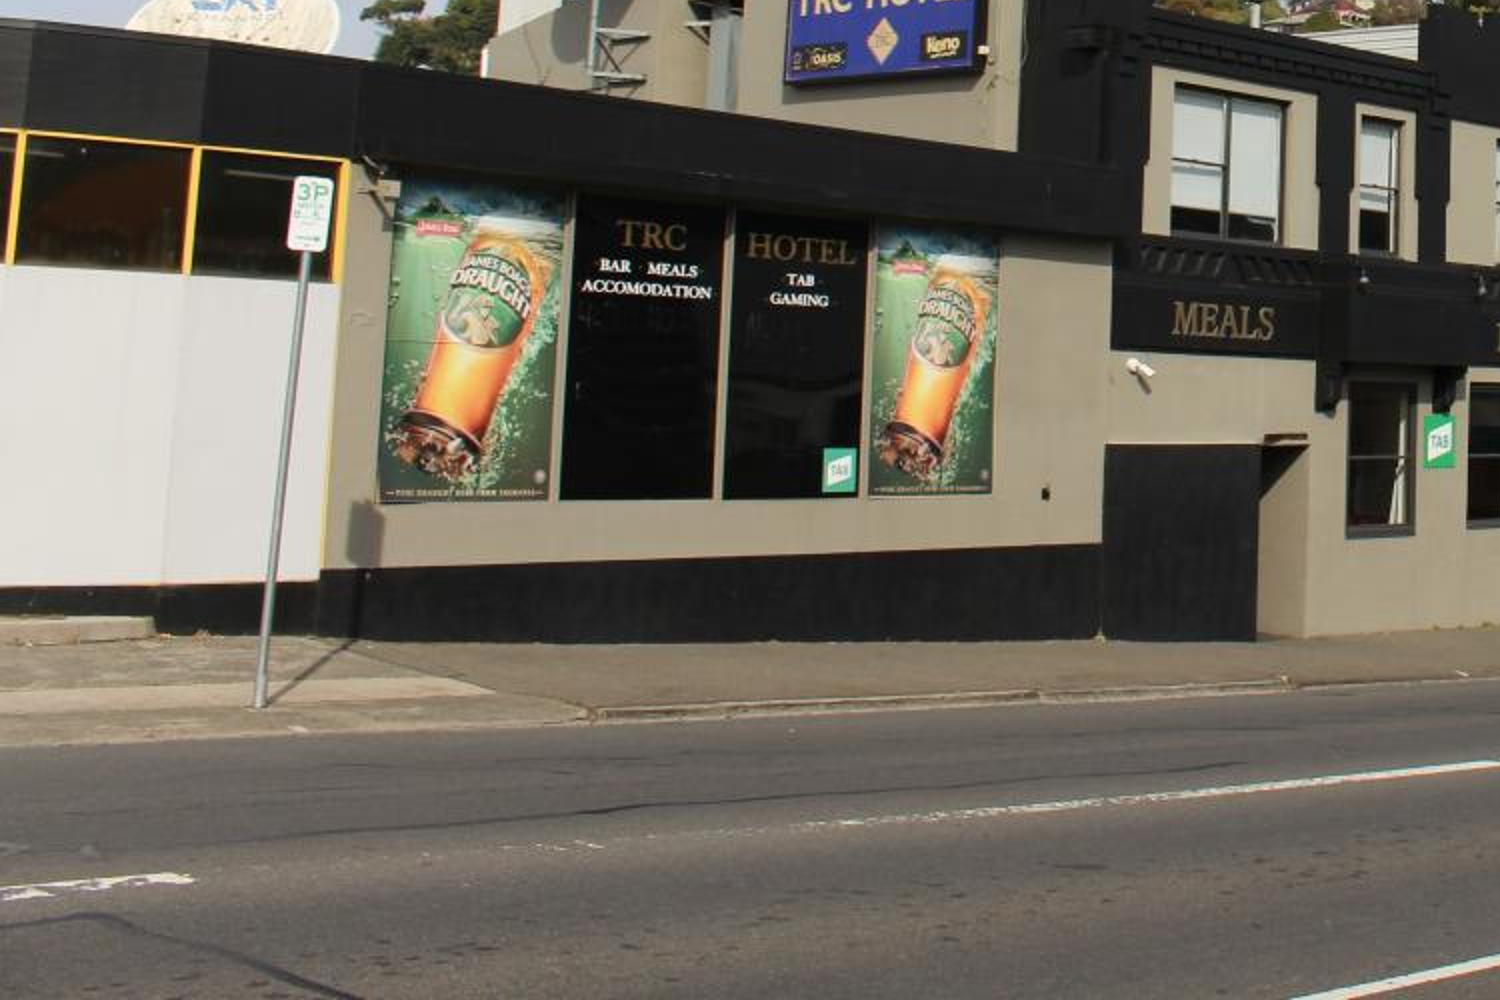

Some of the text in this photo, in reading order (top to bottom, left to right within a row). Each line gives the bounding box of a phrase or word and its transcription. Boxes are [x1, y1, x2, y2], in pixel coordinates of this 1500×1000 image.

[297, 183, 329, 201] 3P
[616, 218, 856, 266] TRC HOTEL
[599, 257, 699, 278] BAR MEALS
[581, 279, 713, 300] ACCOMODATION
[785, 272, 816, 287] TAB
[451, 267, 532, 319] DRAUGHT
[769, 291, 829, 308] GAMING
[1170, 300, 1276, 341] MEALS
[1430, 434, 1449, 449] TAB
